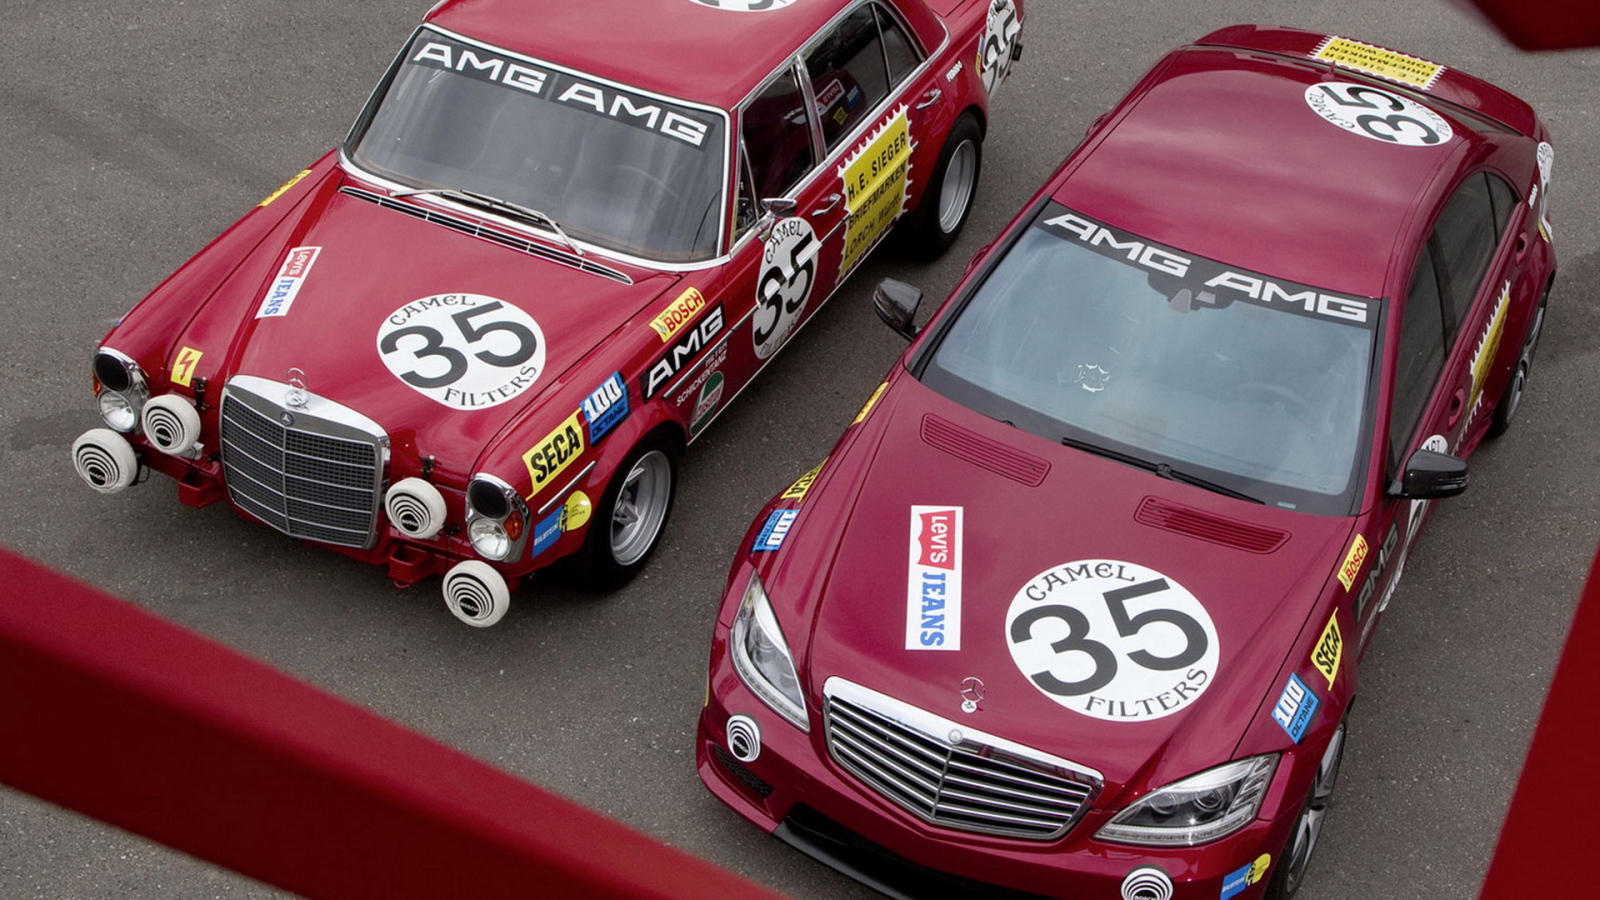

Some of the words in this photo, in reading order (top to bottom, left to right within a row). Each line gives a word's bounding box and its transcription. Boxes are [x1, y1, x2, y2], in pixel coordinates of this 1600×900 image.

[413, 42, 548, 94] AMG
[558, 82, 708, 146] AMG
[1308, 92, 1356, 129] CAMEL
[1317, 85, 1441, 145] 35
[871, 131, 907, 177] SIEGER
[848, 160, 908, 230] BRIEFMARKEN
[765, 220, 803, 264] CAMEL
[754, 230, 814, 347] 35
[1043, 213, 1192, 278] AMG
[1204, 271, 1367, 323] AMG
[263, 278, 295, 316] JEANS
[389, 295, 476, 326] CAMEL
[662, 290, 703, 332] BOSCH
[380, 300, 537, 389] 35
[646, 306, 724, 399] AMG
[444, 365, 537, 406] FILTERS
[582, 376, 623, 424] 100
[676, 350, 728, 407] SCHICKENTANZ
[592, 403, 626, 438] OCTANE
[531, 424, 581, 484] SECA
[1025, 562, 1136, 602] CAMEL
[1344, 538, 1368, 582] BOSCH
[1356, 521, 1399, 624] AMG
[919, 571, 947, 647] JEANS
[1010, 577, 1209, 697] 35
[1315, 624, 1341, 675] SECA
[1084, 668, 1208, 718] FILTERS
[1274, 678, 1306, 728] 100
[1291, 695, 1315, 738] OCTANE
